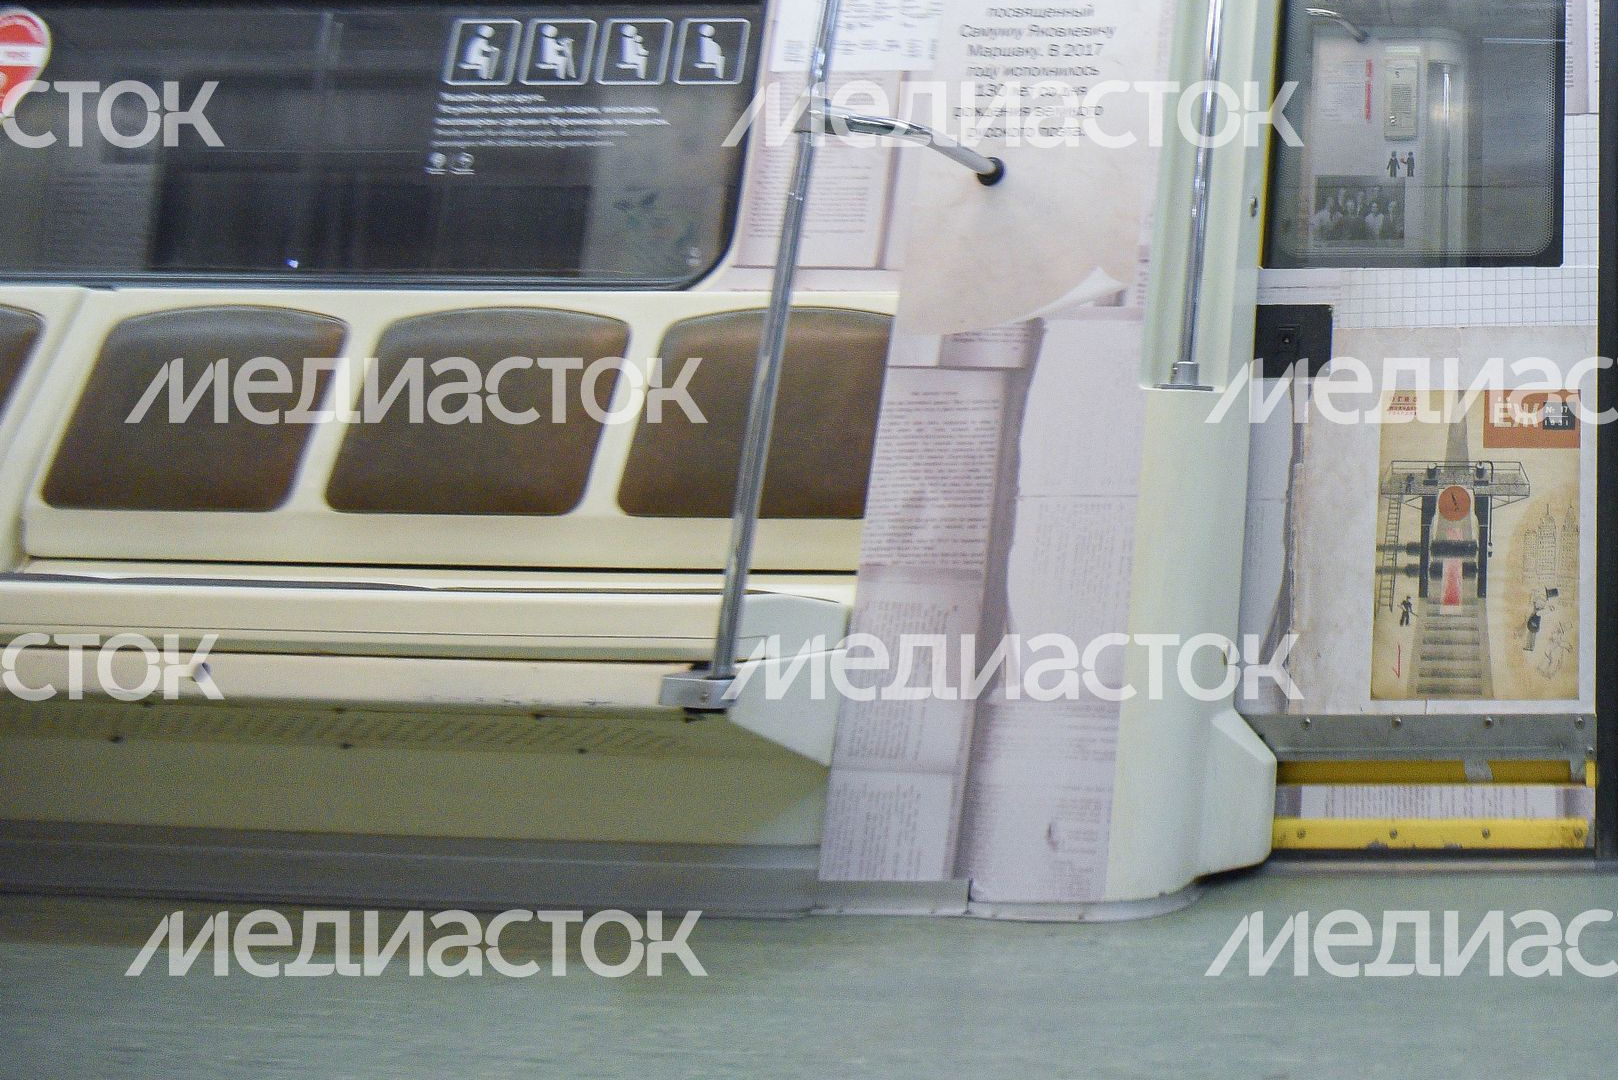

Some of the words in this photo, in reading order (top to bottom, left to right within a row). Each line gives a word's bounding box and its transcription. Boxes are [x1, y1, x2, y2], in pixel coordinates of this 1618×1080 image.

[985, 4, 1095, 19] посвященный
[959, 24, 1024, 41] Самуилу
[1027, 24, 1117, 40] Яковлевичу
[966, 43, 1043, 60] Маршаку.
[1048, 44, 1061, 57] В
[1065, 43, 1104, 57] 2017
[966, 65, 999, 80] году
[1004, 64, 1100, 77] исполнилось
[1494, 396, 1540, 428] ЁЖ
